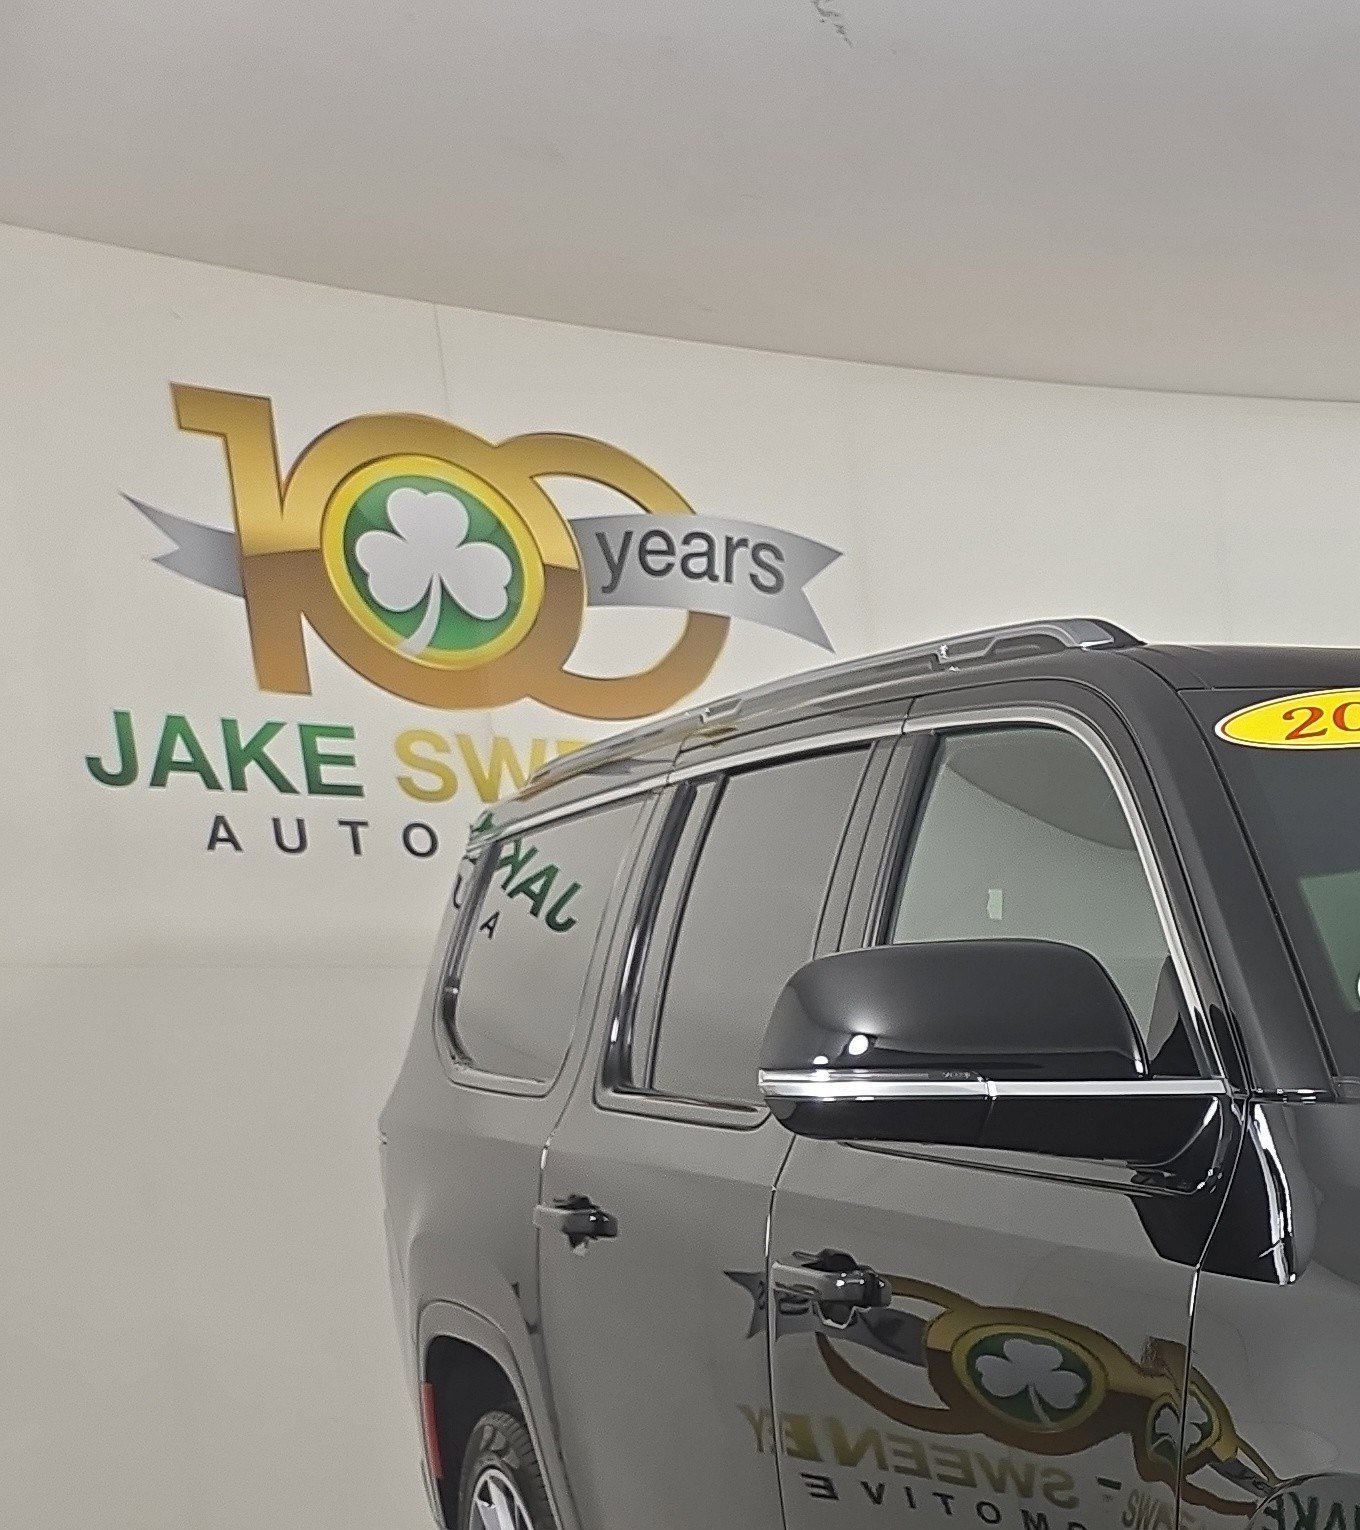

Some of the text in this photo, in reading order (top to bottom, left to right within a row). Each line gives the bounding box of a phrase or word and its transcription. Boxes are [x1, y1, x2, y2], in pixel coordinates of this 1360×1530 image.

[170, 382, 786, 721] 100 years
[85, 709, 365, 798] JAKE
[205, 814, 439, 858] AUTO
